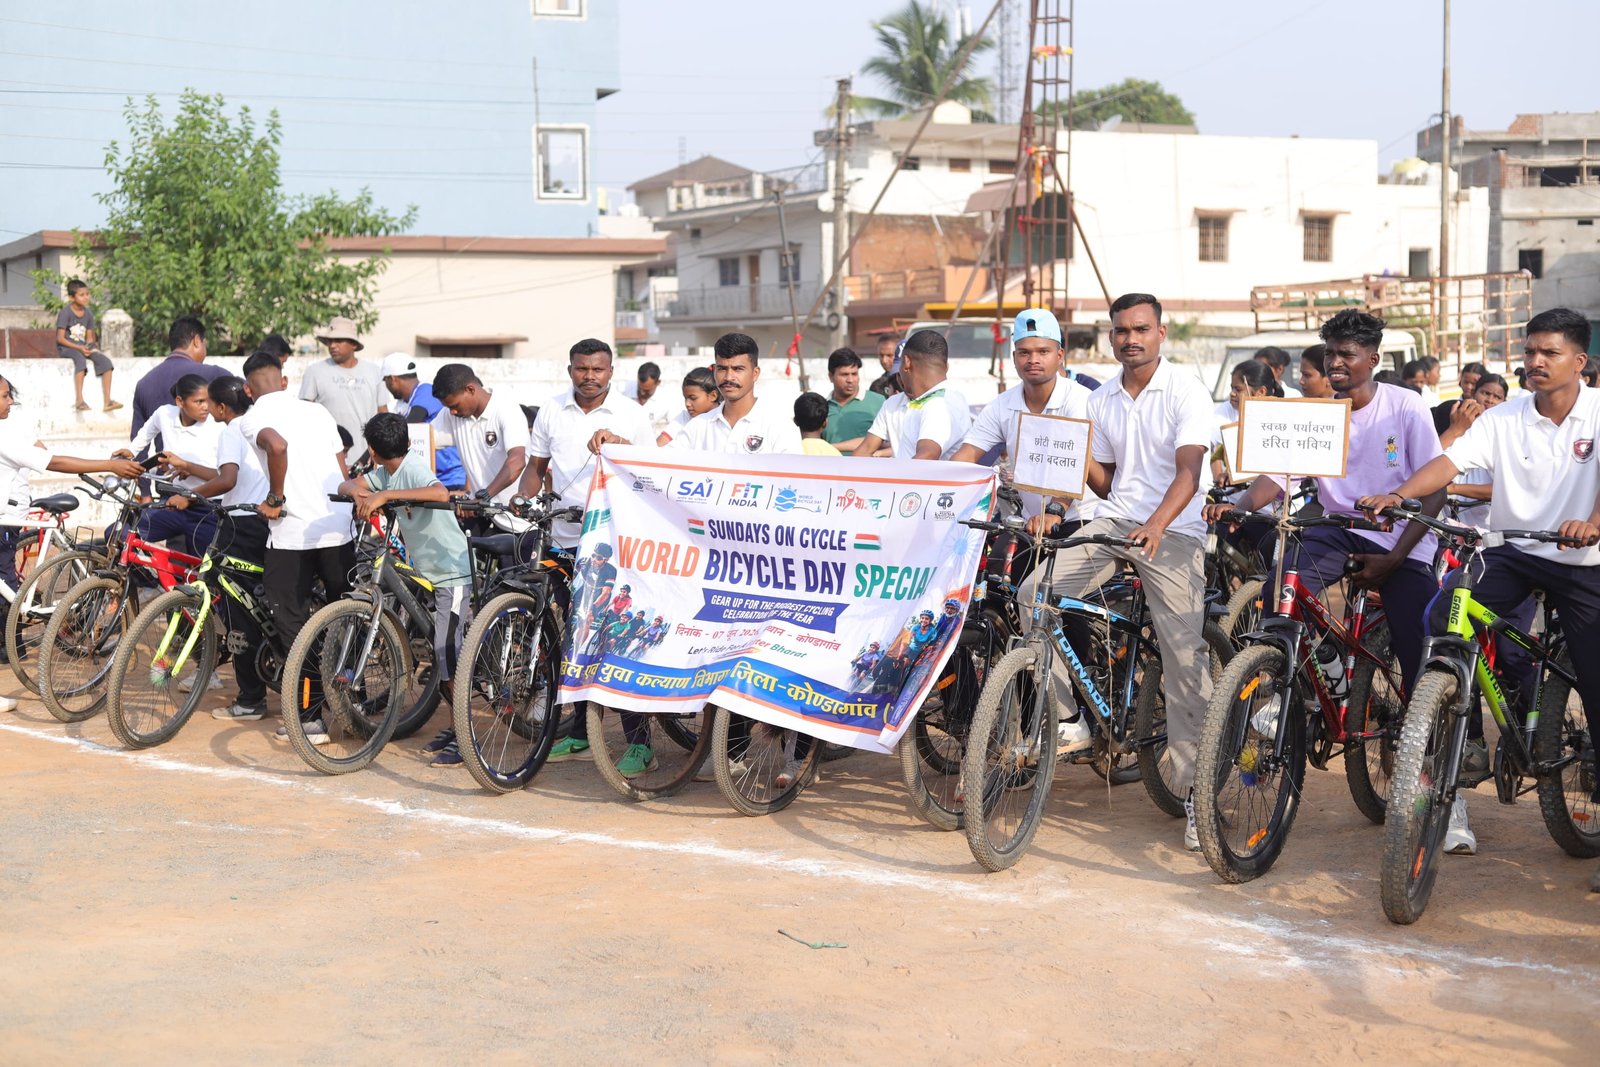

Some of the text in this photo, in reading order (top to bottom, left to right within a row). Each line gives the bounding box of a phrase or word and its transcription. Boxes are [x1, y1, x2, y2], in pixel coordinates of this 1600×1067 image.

[1260, 421, 1336, 434] स्वच्छ पर्यावरण
[1034, 434, 1075, 451] छोटी सवारी
[1262, 435, 1332, 451] हरित भविष्य
[1029, 452, 1077, 468] बड़ा बदलाव
[728, 498, 758, 508] INDIA
[855, 496, 882, 511] भात
[708, 518, 847, 551] SUNDAYS ON CYCLE
[618, 535, 700, 578] WORLD
[704, 548, 797, 591] BICYCLE
[803, 559, 847, 596] DAY
[711, 594, 732, 607] GEAR
[732, 597, 744, 609] UP
[744, 599, 760, 610] FOR
[760, 601, 775, 610] THE
[804, 605, 836, 617] CYCLING
[1449, 595, 1462, 626] GANG
[722, 608, 769, 620] CELEBRATION
[777, 609, 795, 619] THE
[792, 612, 815, 625] YEAR
[1482, 610, 1498, 622] GANG
[674, 624, 703, 638] दिनांक
[712, 631, 725, 640] 07
[764, 625, 786, 637] थान
[795, 632, 842, 652] कोण्डागांव
[687, 646, 707, 655] Let's
[769, 643, 808, 659] Bharat
[598, 662, 636, 683] युवा
[635, 672, 692, 689] कल्याण
[691, 668, 730, 689] विभाग
[1053, 622, 1112, 717] TORNADO
